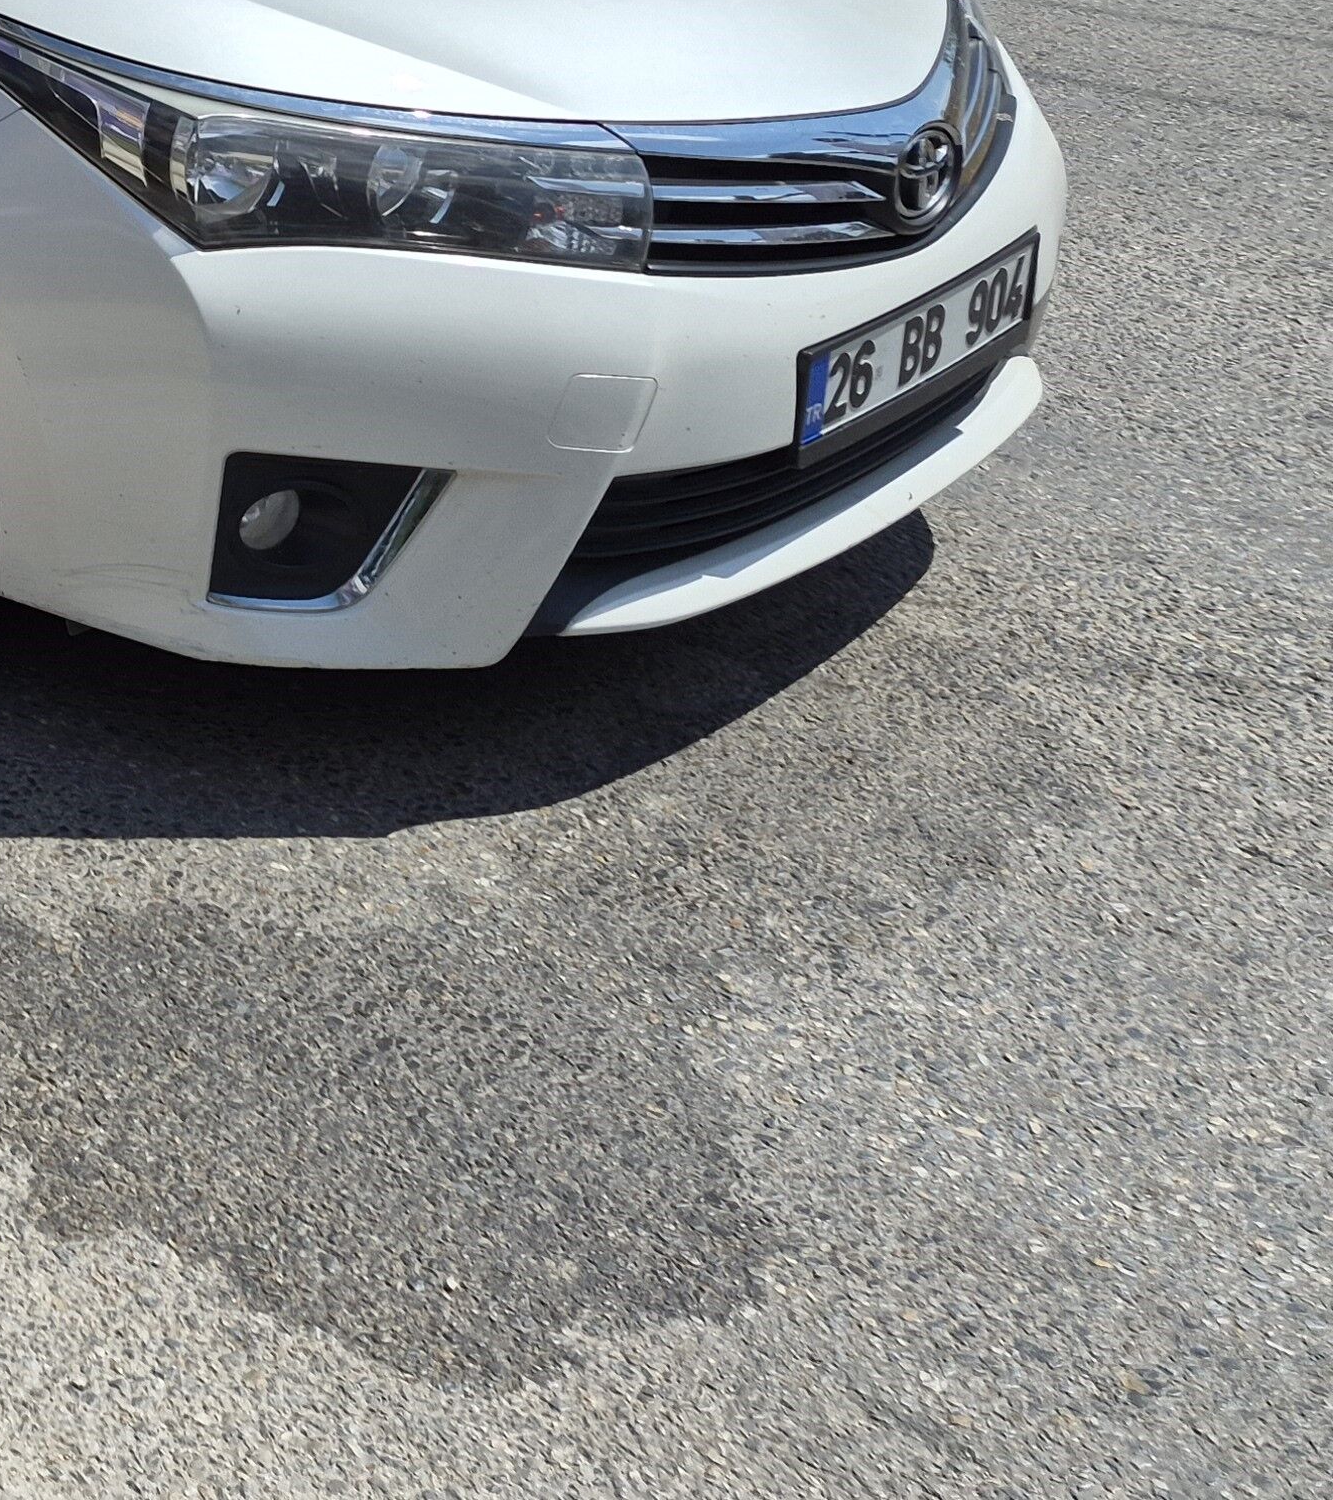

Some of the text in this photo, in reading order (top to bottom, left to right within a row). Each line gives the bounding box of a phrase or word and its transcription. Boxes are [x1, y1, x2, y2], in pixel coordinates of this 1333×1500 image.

[823, 255, 1026, 426] 26 BB 904
[805, 403, 823, 426] TR
